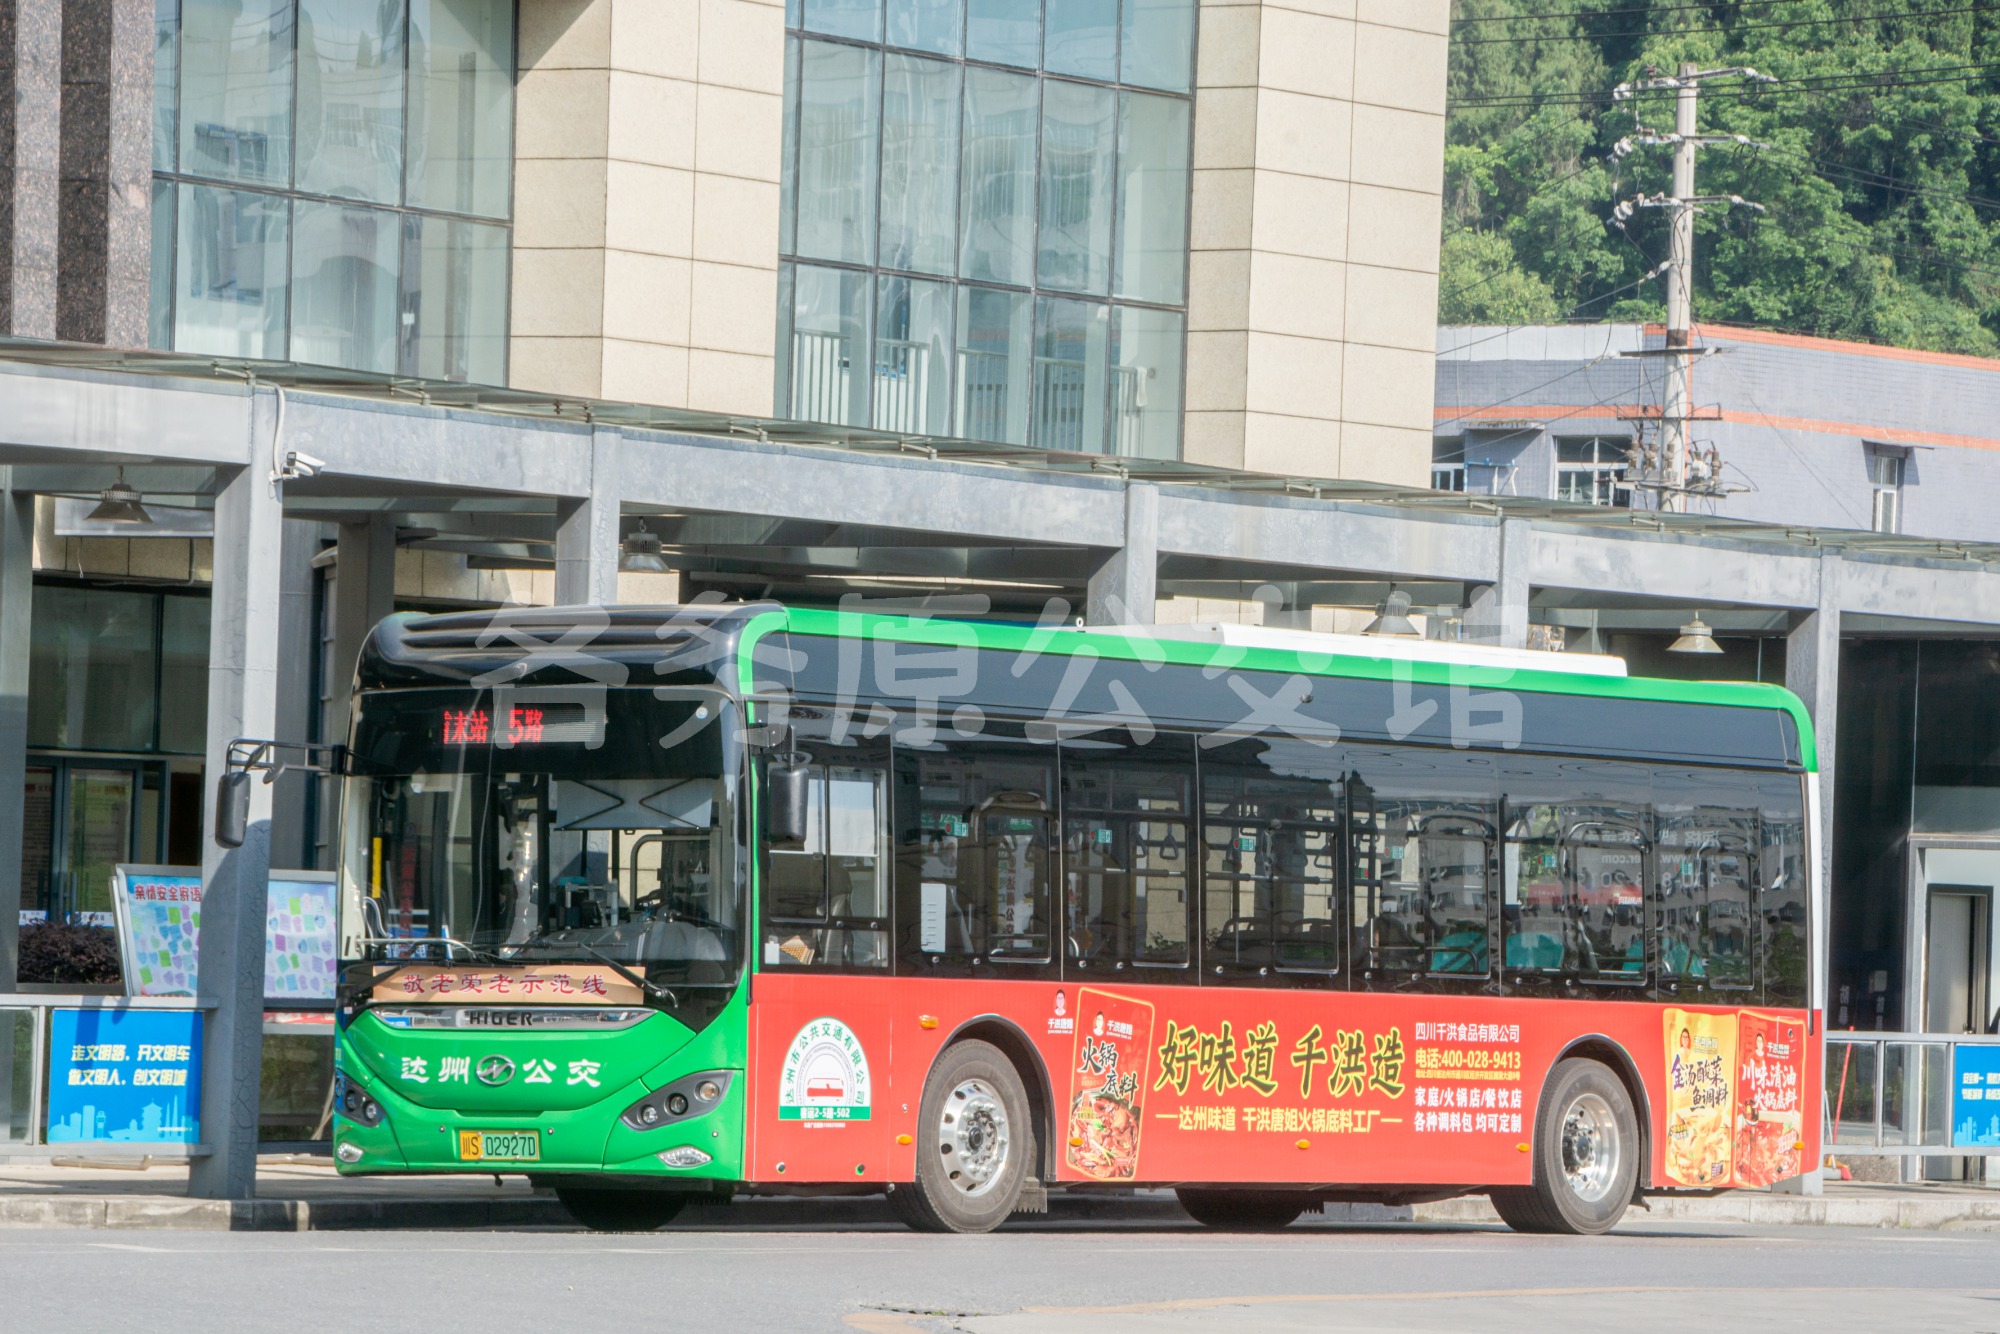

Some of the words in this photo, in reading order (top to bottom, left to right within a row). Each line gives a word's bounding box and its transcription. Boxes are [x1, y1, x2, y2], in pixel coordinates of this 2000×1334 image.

[508, 709, 544, 744] 5路
[135, 884, 202, 902] 亲情安全寄语
[403, 973, 608, 996] 敬老爱老示范线
[470, 1010, 533, 1026] HIGER
[1415, 1022, 1520, 1043] 四川千洪食品有限公司
[785, 1021, 865, 1105] 达州市公共交通有限公司
[1077, 1036, 1119, 1075] 火锅
[1153, 1019, 1281, 1098] 好味道
[1291, 1022, 1406, 1099] 千洪造
[1415, 1047, 1521, 1069] 电话:400-028-9413
[401, 1056, 471, 1085] 达州
[523, 1058, 601, 1088] 公交
[1671, 1053, 1725, 1093] 金汤酸菜
[1741, 1058, 1797, 1091] 川味清油
[1100, 1072, 1139, 1110] 底料
[1414, 1086, 1522, 1109] 家庭/火锅店/餐饮店
[1690, 1083, 1729, 1112] 鱼调料
[1752, 1088, 1798, 1115] 火锅底料
[1414, 1111, 1473, 1133] 各种调料包
[1475, 1113, 1522, 1133] 均可定制
[462, 1137, 480, 1157] 川S
[486, 1136, 536, 1157] 02927D
